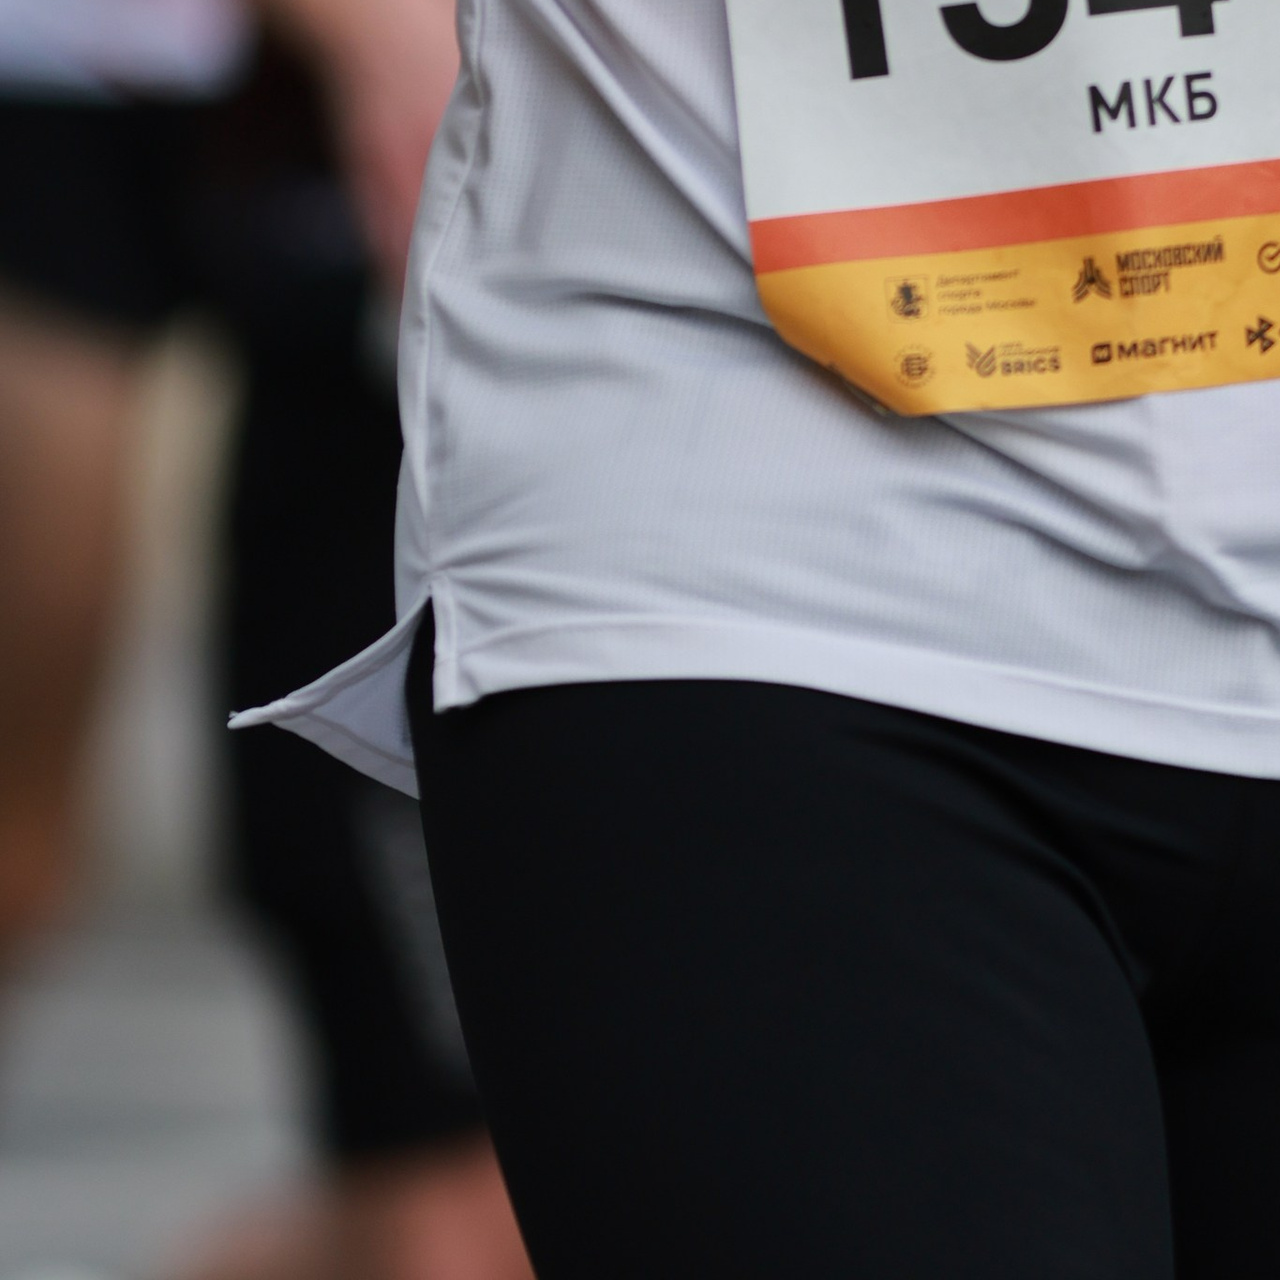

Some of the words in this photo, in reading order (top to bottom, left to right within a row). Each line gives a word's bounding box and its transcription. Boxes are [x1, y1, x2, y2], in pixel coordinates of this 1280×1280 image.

[1086, 71, 1220, 135] МКБ
[1115, 235, 1224, 274] МОСКОВСКИЙ
[1118, 271, 1171, 299] СПОРТ
[1001, 355, 1061, 377] BRICS
